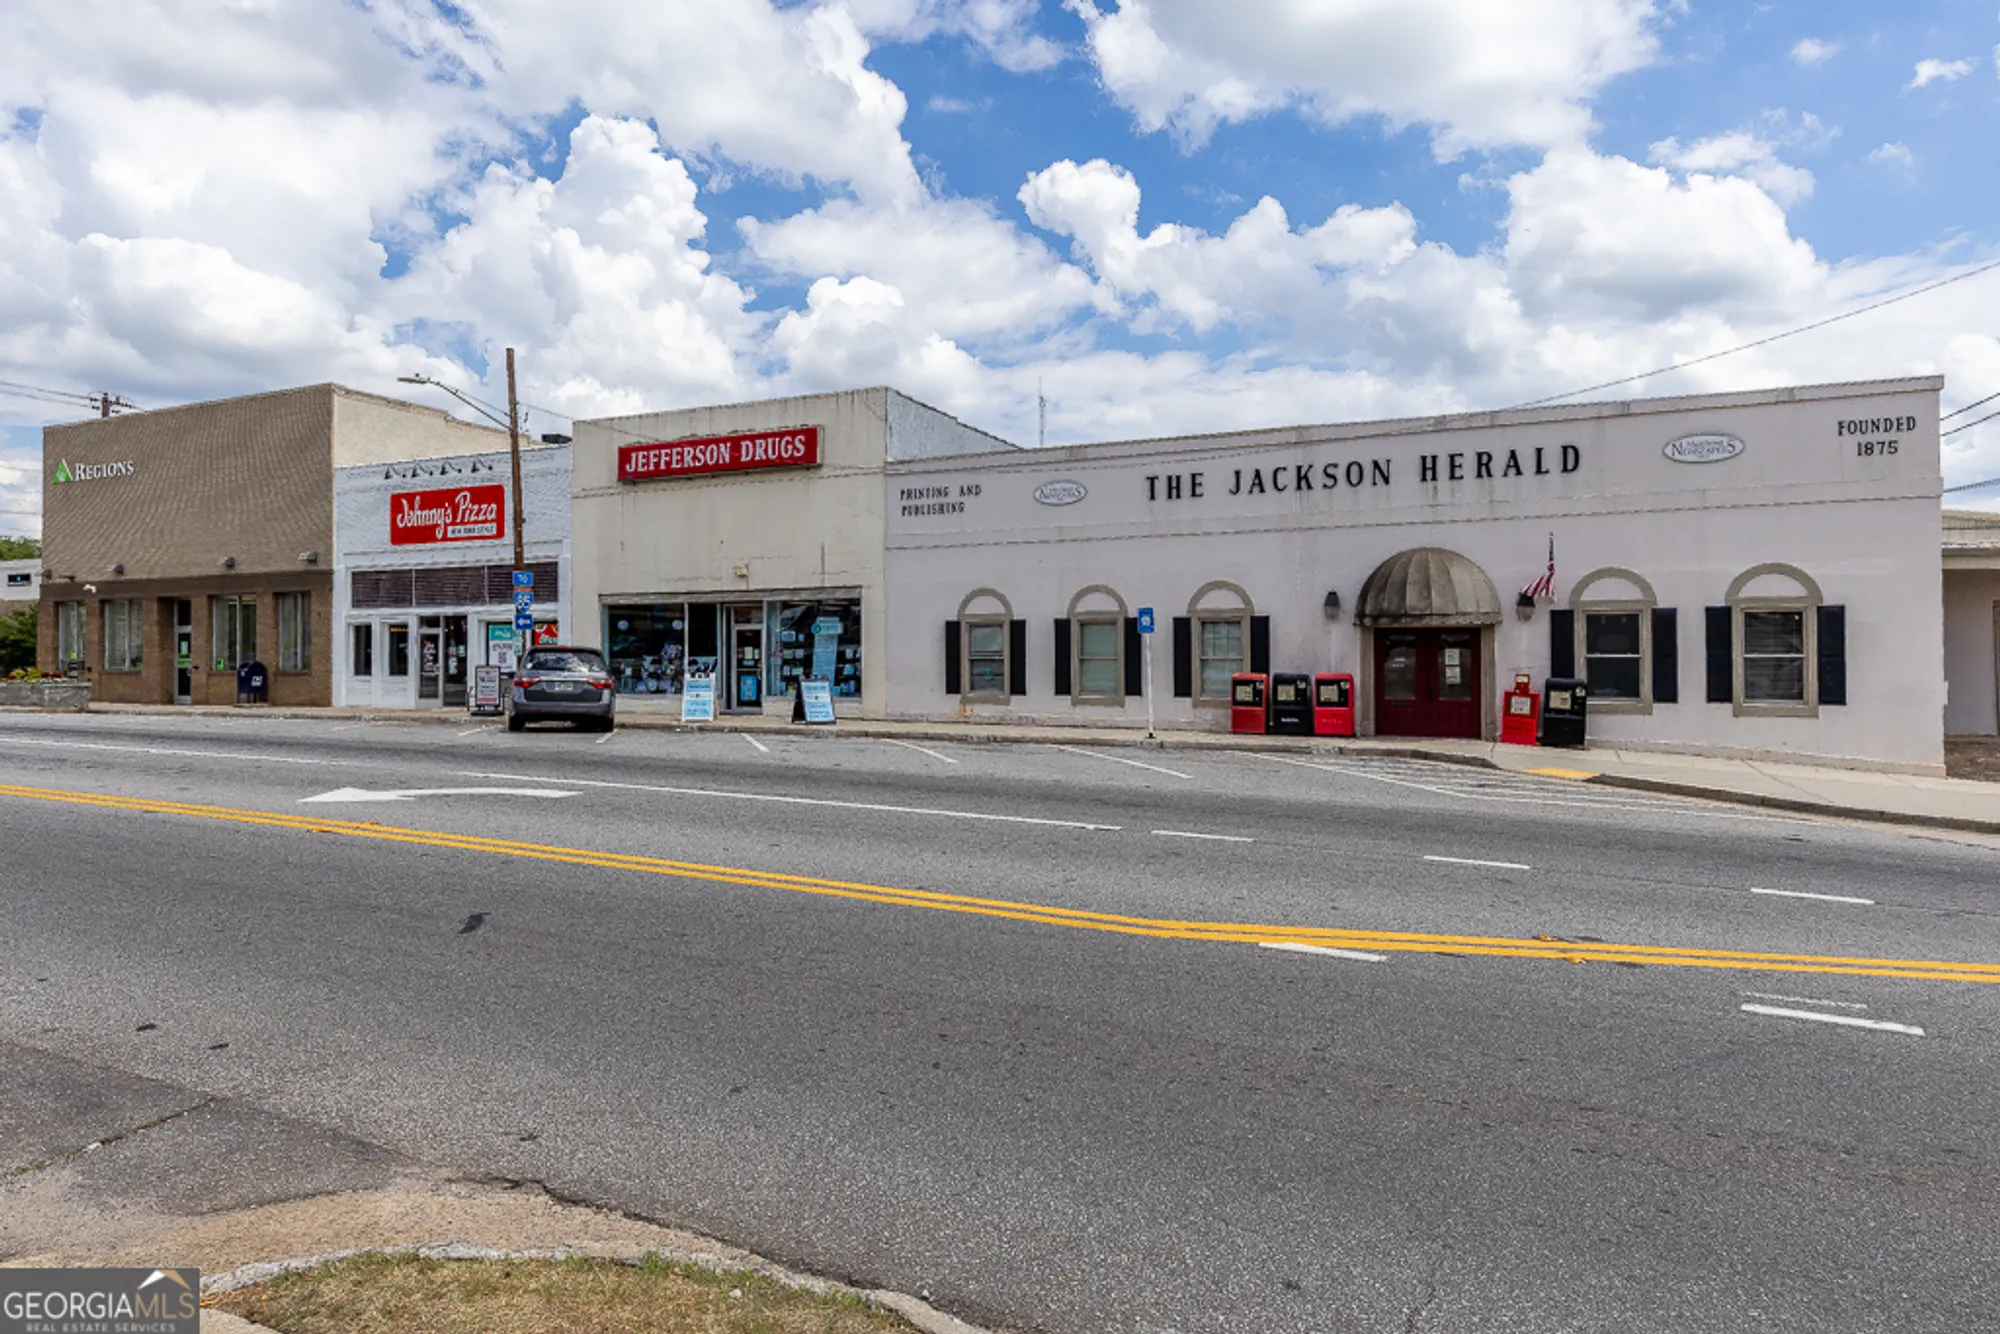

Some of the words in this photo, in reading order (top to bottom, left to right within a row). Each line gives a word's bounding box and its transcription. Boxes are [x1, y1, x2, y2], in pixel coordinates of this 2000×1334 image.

[1837, 415, 1917, 436] FOUNDED
[625, 442, 732, 472] JEFFERSON
[740, 434, 806, 463] DRUGS
[1857, 440, 1899, 456] 1875
[1145, 472, 1205, 501] THE
[1229, 458, 1392, 495] JACKSON
[1420, 444, 1581, 482] HERALD
[900, 486, 949, 501] PRINTING
[959, 484, 982, 498] AND
[396, 495, 453, 539] Johnny's
[455, 491, 498, 523] Pizza
[901, 501, 965, 516] PUBLISHING
